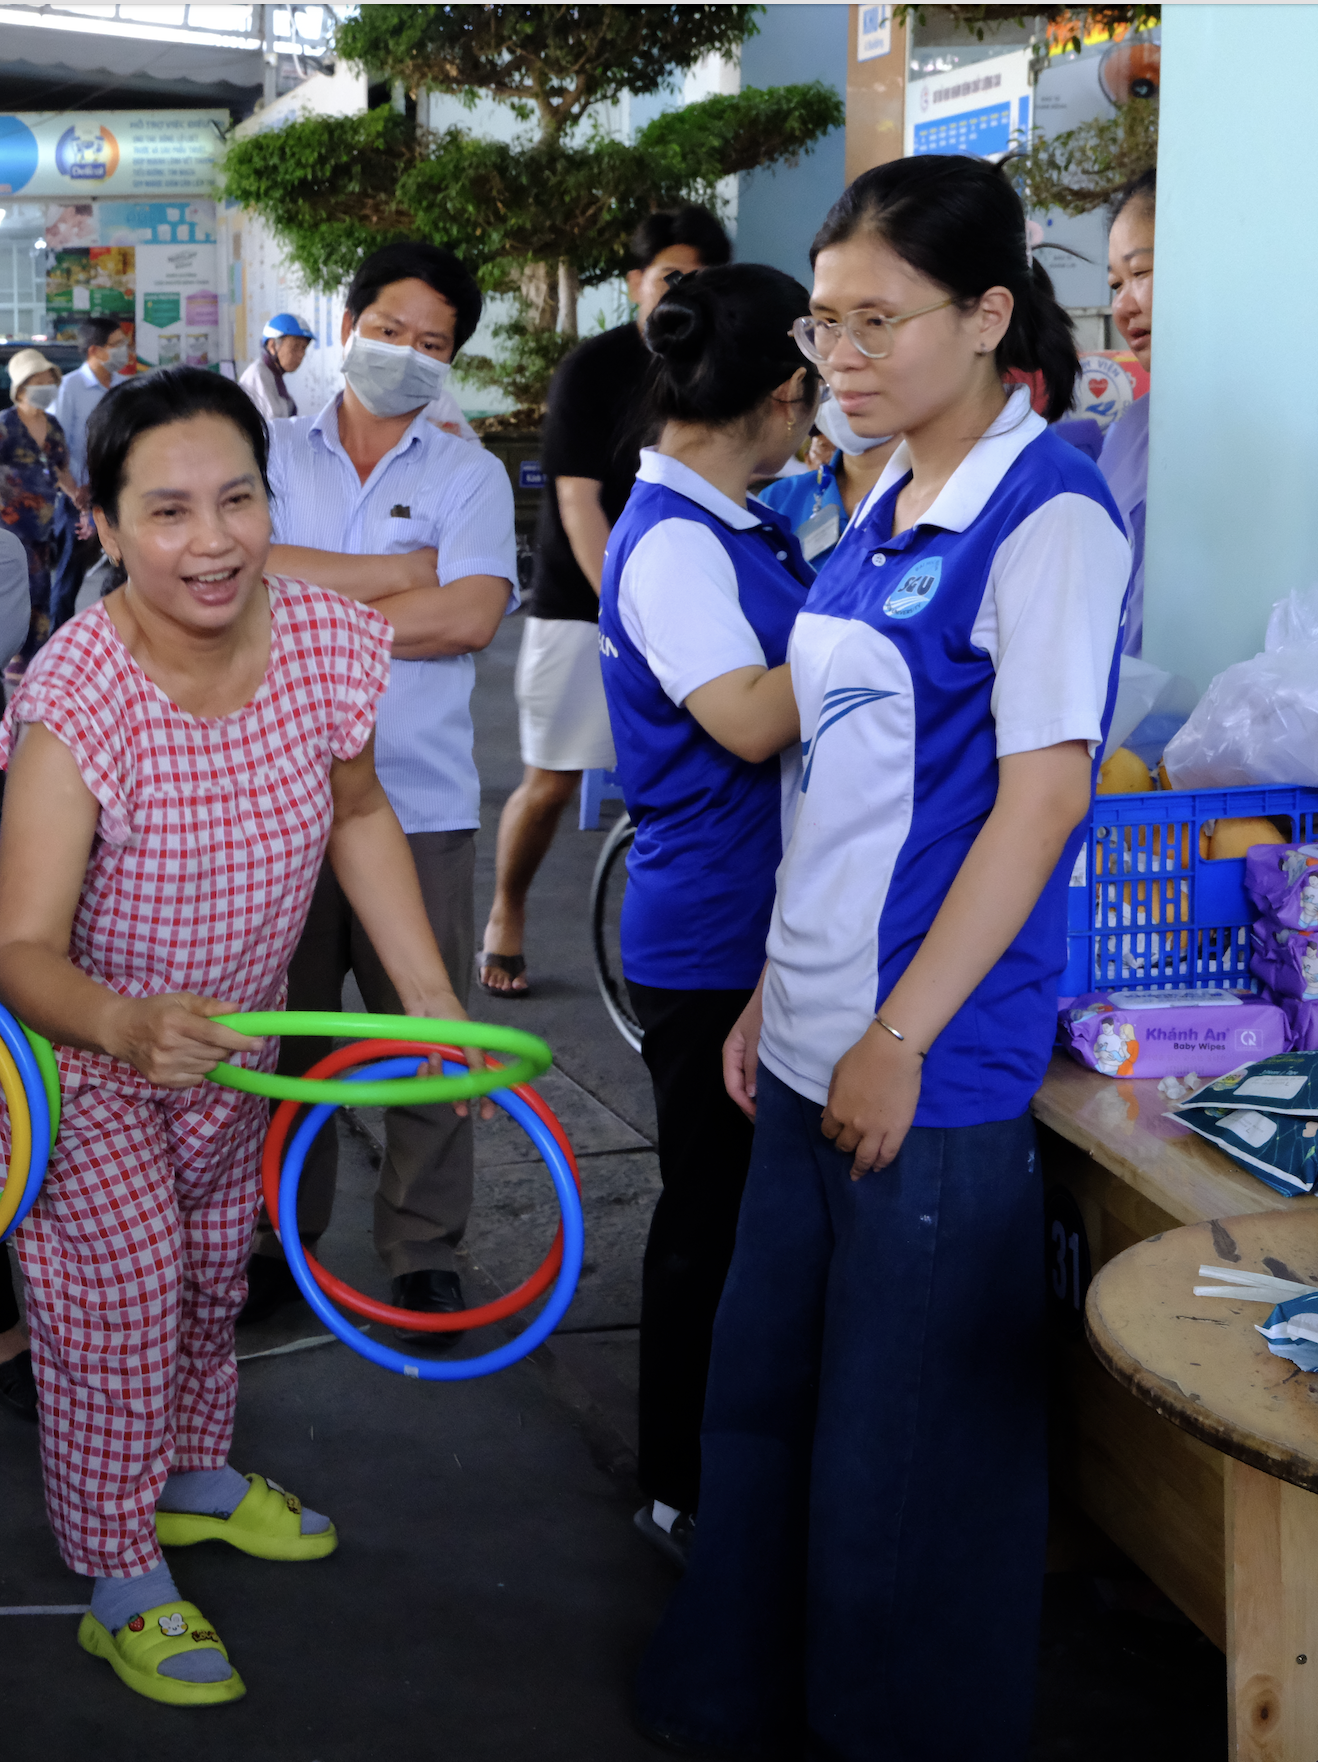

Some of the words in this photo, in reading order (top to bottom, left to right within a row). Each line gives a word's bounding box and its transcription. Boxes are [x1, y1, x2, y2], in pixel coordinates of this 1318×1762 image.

[1145, 1027, 1198, 1042] Khánh
[1203, 1028, 1227, 1041] An
[1173, 1042, 1196, 1052] Baby
[1198, 1042, 1227, 1052] Wipes
